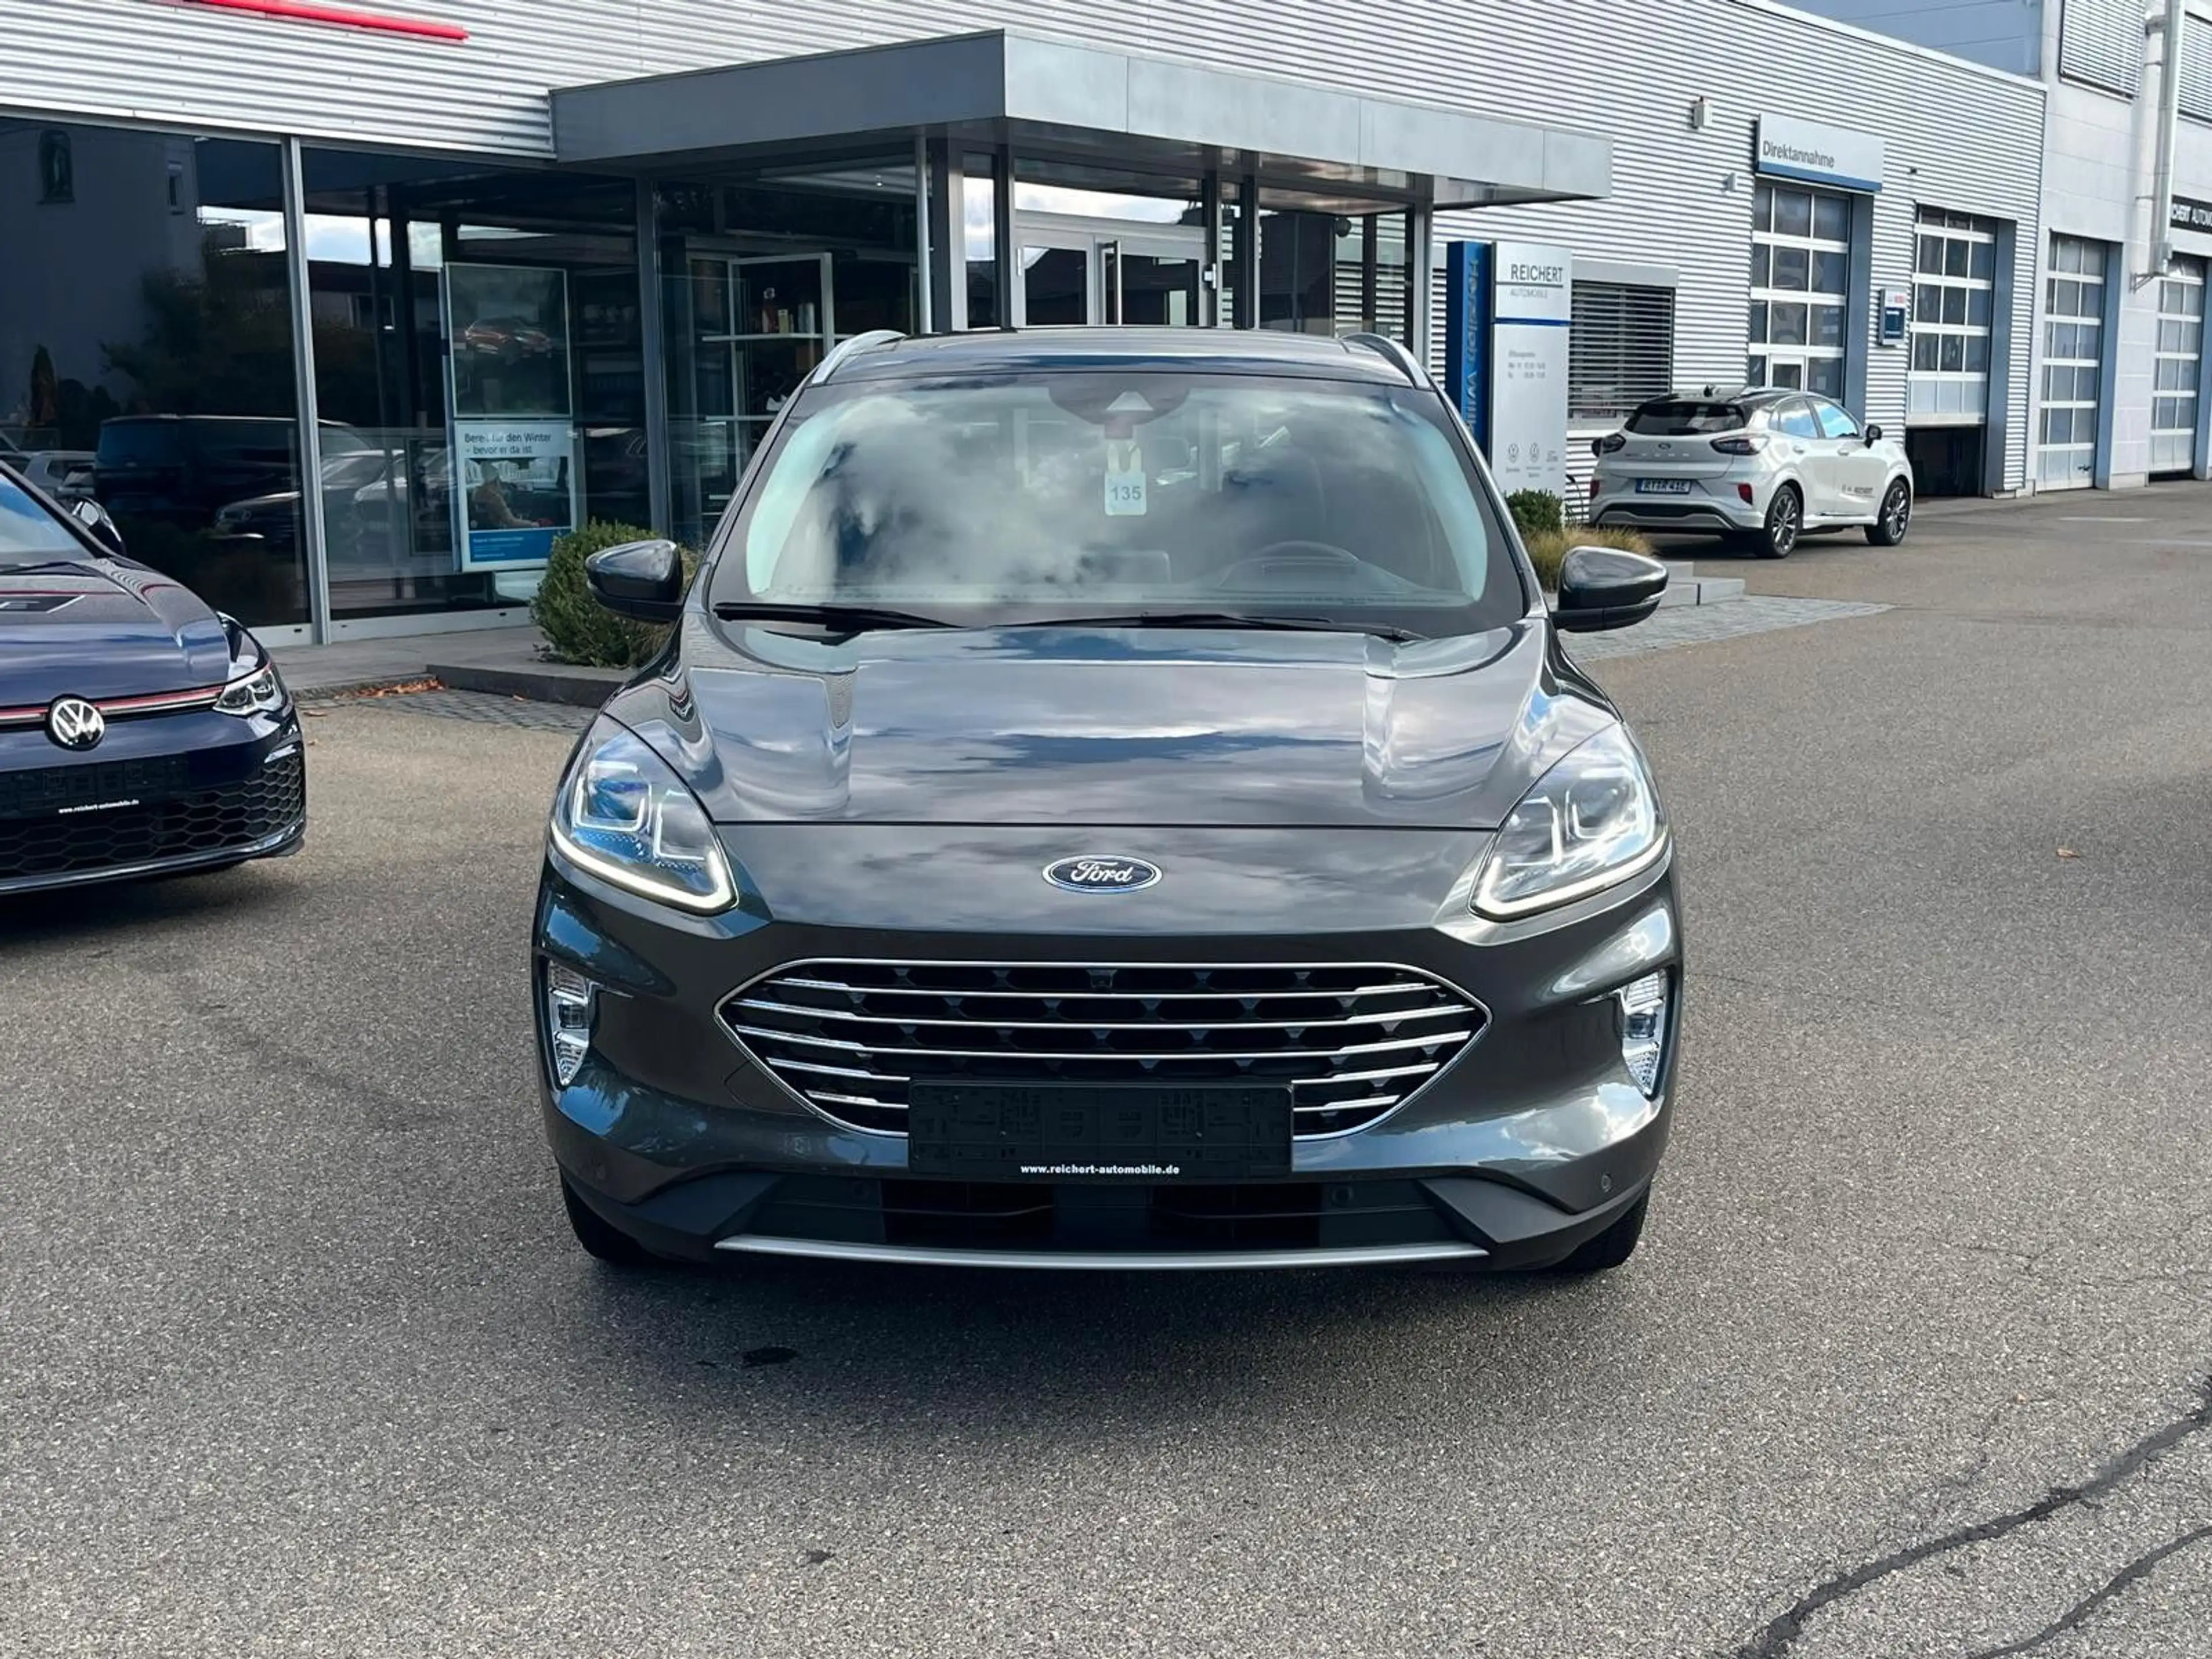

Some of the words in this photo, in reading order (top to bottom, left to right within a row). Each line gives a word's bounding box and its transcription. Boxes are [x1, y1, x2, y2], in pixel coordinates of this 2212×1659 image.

[1763, 140, 1835, 168] Direktannahme
[1510, 264, 1563, 282] REICHERT
[1110, 486, 1142, 501] 135
[1070, 861, 1134, 882] Ford
[1020, 1164, 1180, 1175] www.reichert-automobile.de
